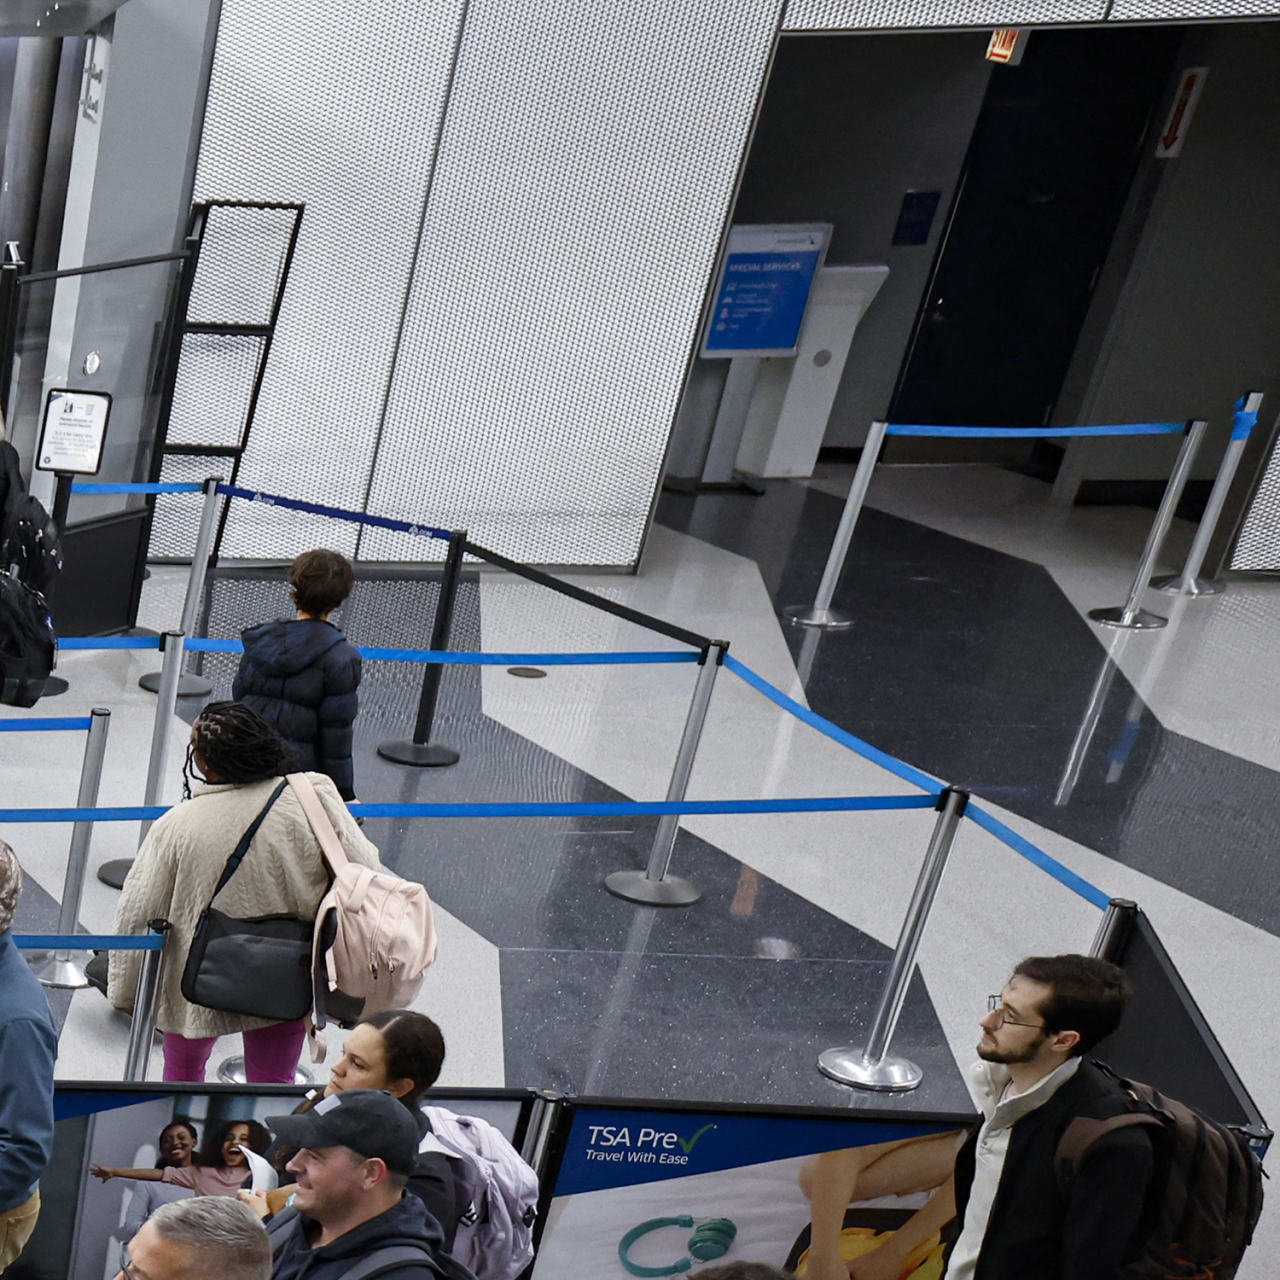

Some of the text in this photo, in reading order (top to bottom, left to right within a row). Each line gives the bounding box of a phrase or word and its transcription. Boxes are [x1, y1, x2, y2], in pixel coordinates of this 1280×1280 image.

[588, 1125, 678, 1149] TSA Pre
[585, 1148, 689, 1165] Travel With Ease
